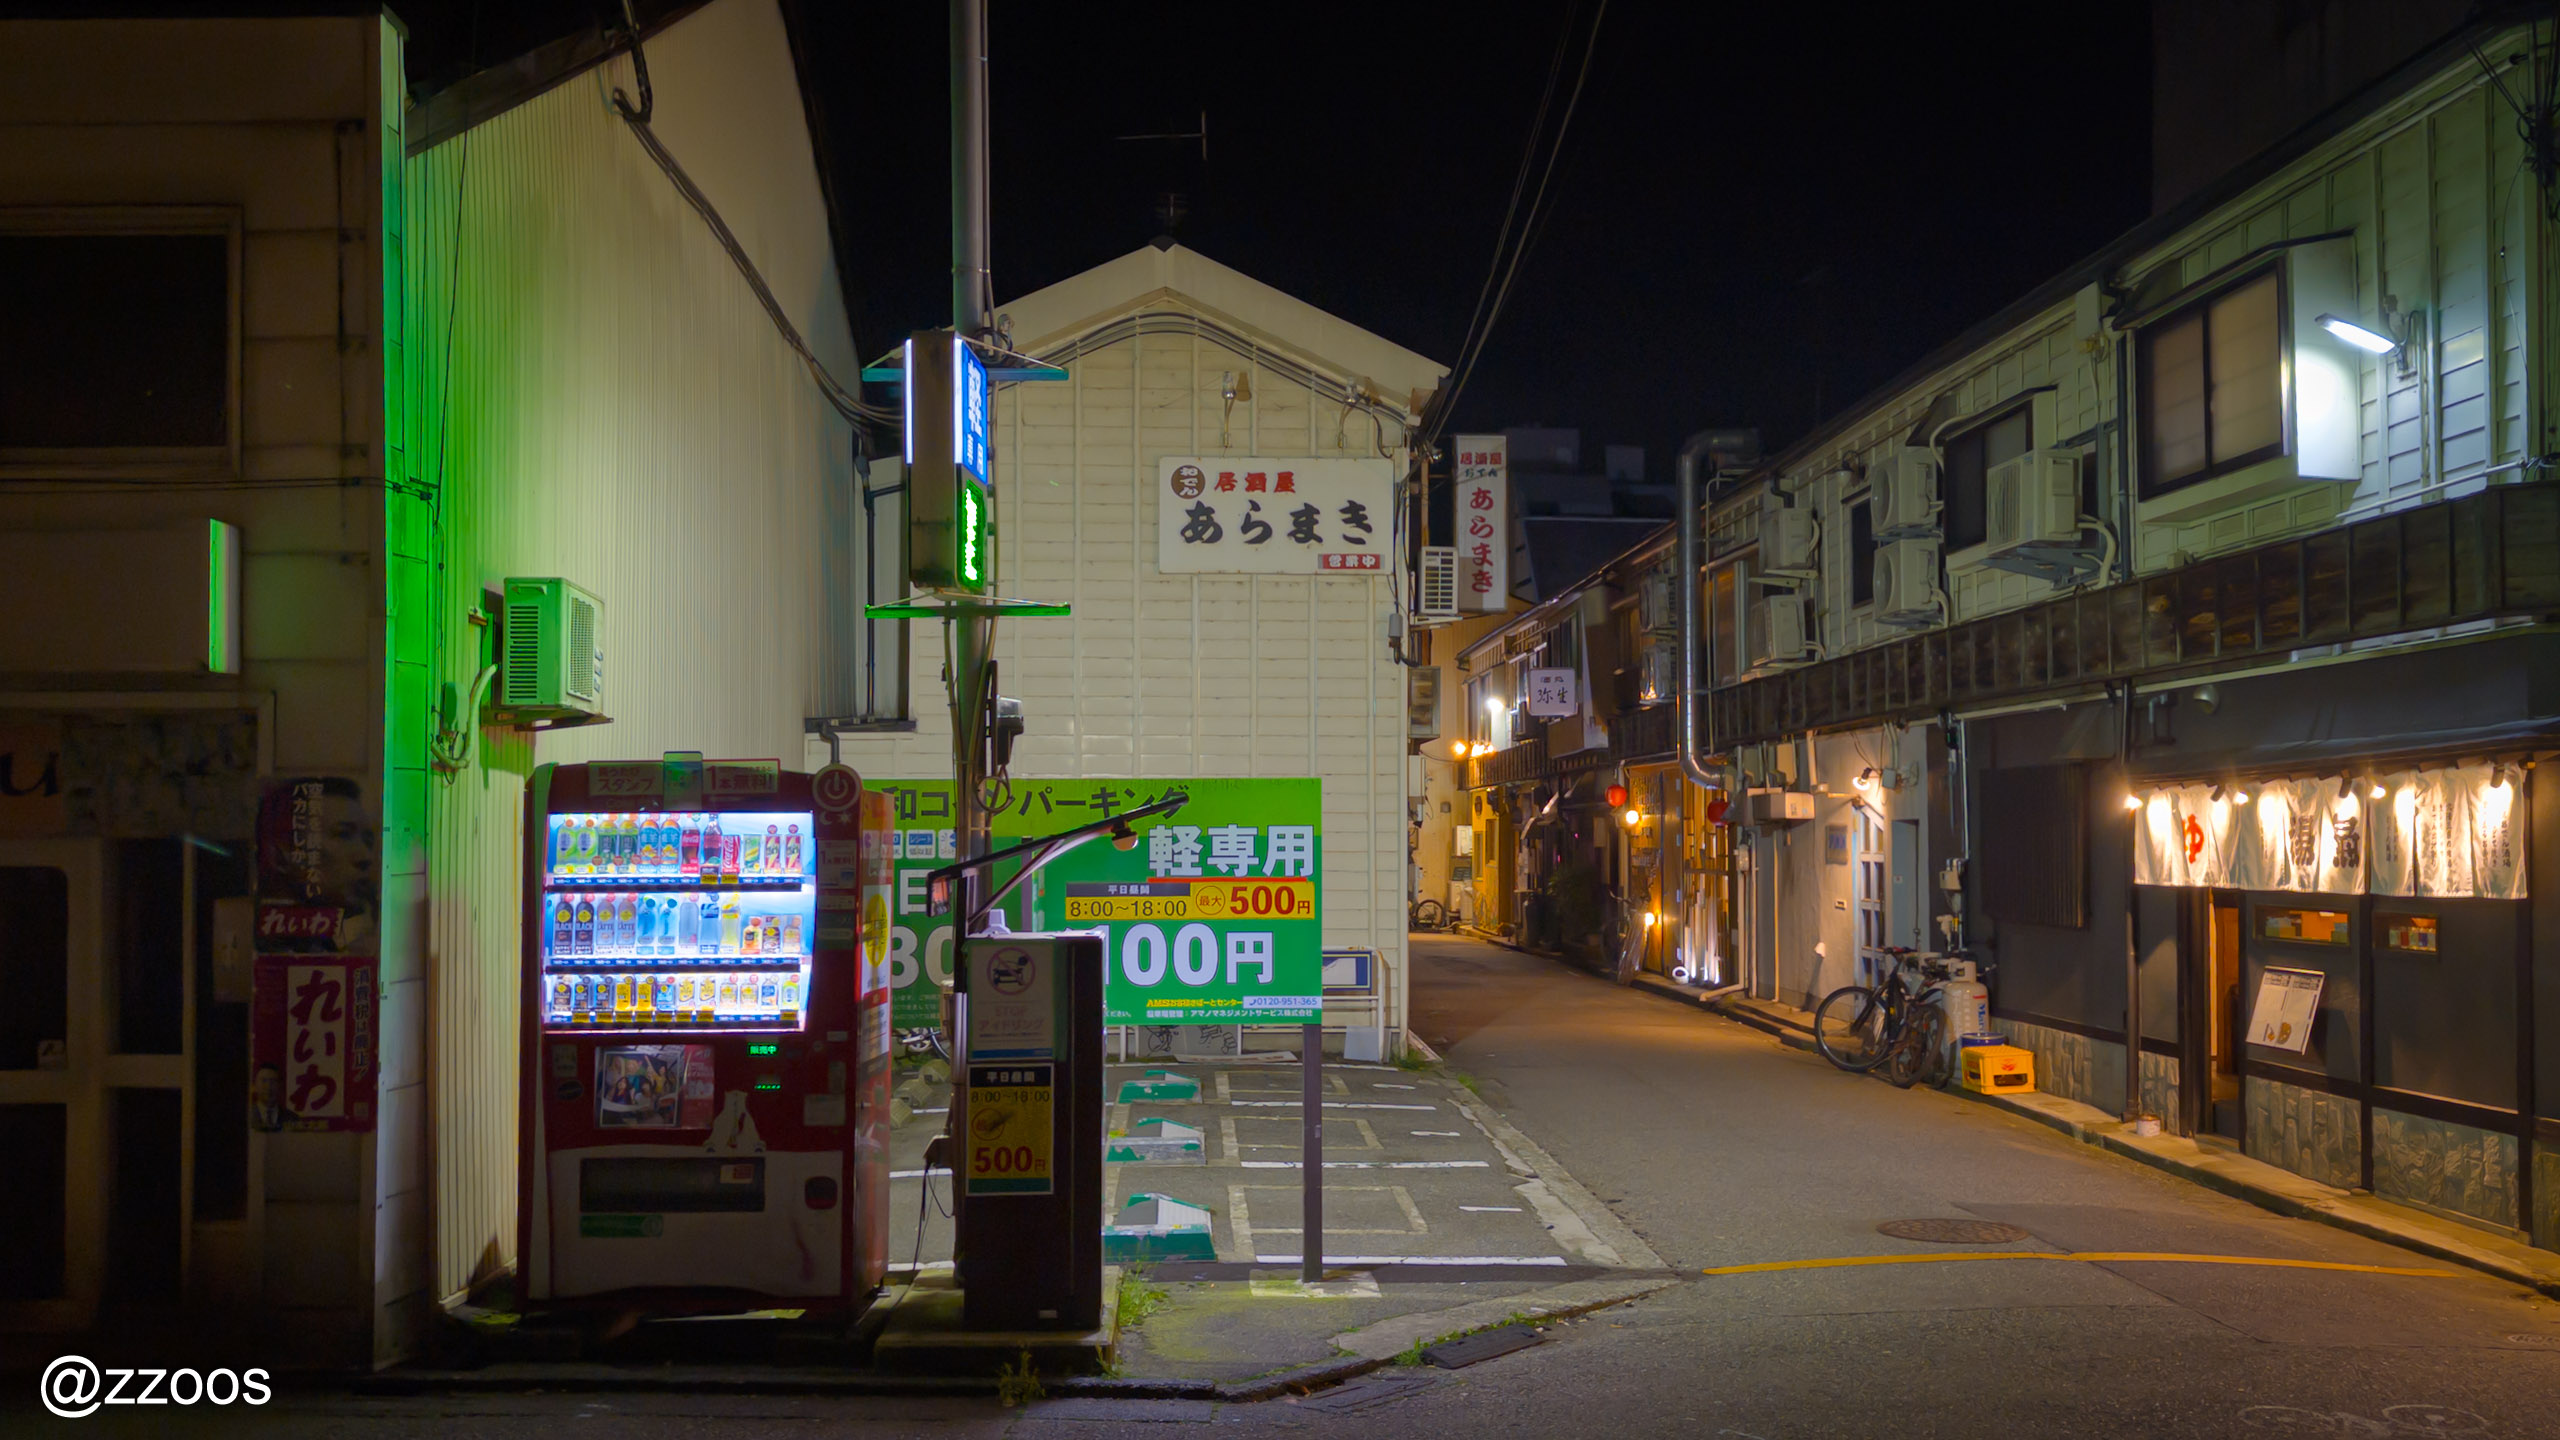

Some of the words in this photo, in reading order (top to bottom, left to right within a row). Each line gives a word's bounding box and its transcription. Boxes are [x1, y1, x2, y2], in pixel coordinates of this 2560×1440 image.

[1460, 452, 1502, 465] 居酒屋
[1179, 466, 1199, 497] おでん
[1214, 471, 1296, 493] 居酒屋
[1180, 500, 1373, 545] あらまき
[1469, 487, 1494, 593] あらまき
[1328, 554, 1376, 568] 営業中
[1537, 687, 1568, 705] 弥生
[1148, 824, 1314, 878] 軽専用
[1200, 895, 1222, 907] 最大
[1229, 886, 1311, 915] 500円
[261, 908, 331, 936] れいわ
[290, 970, 342, 1112] れいわ
[975, 1146, 1047, 1173] 500円
